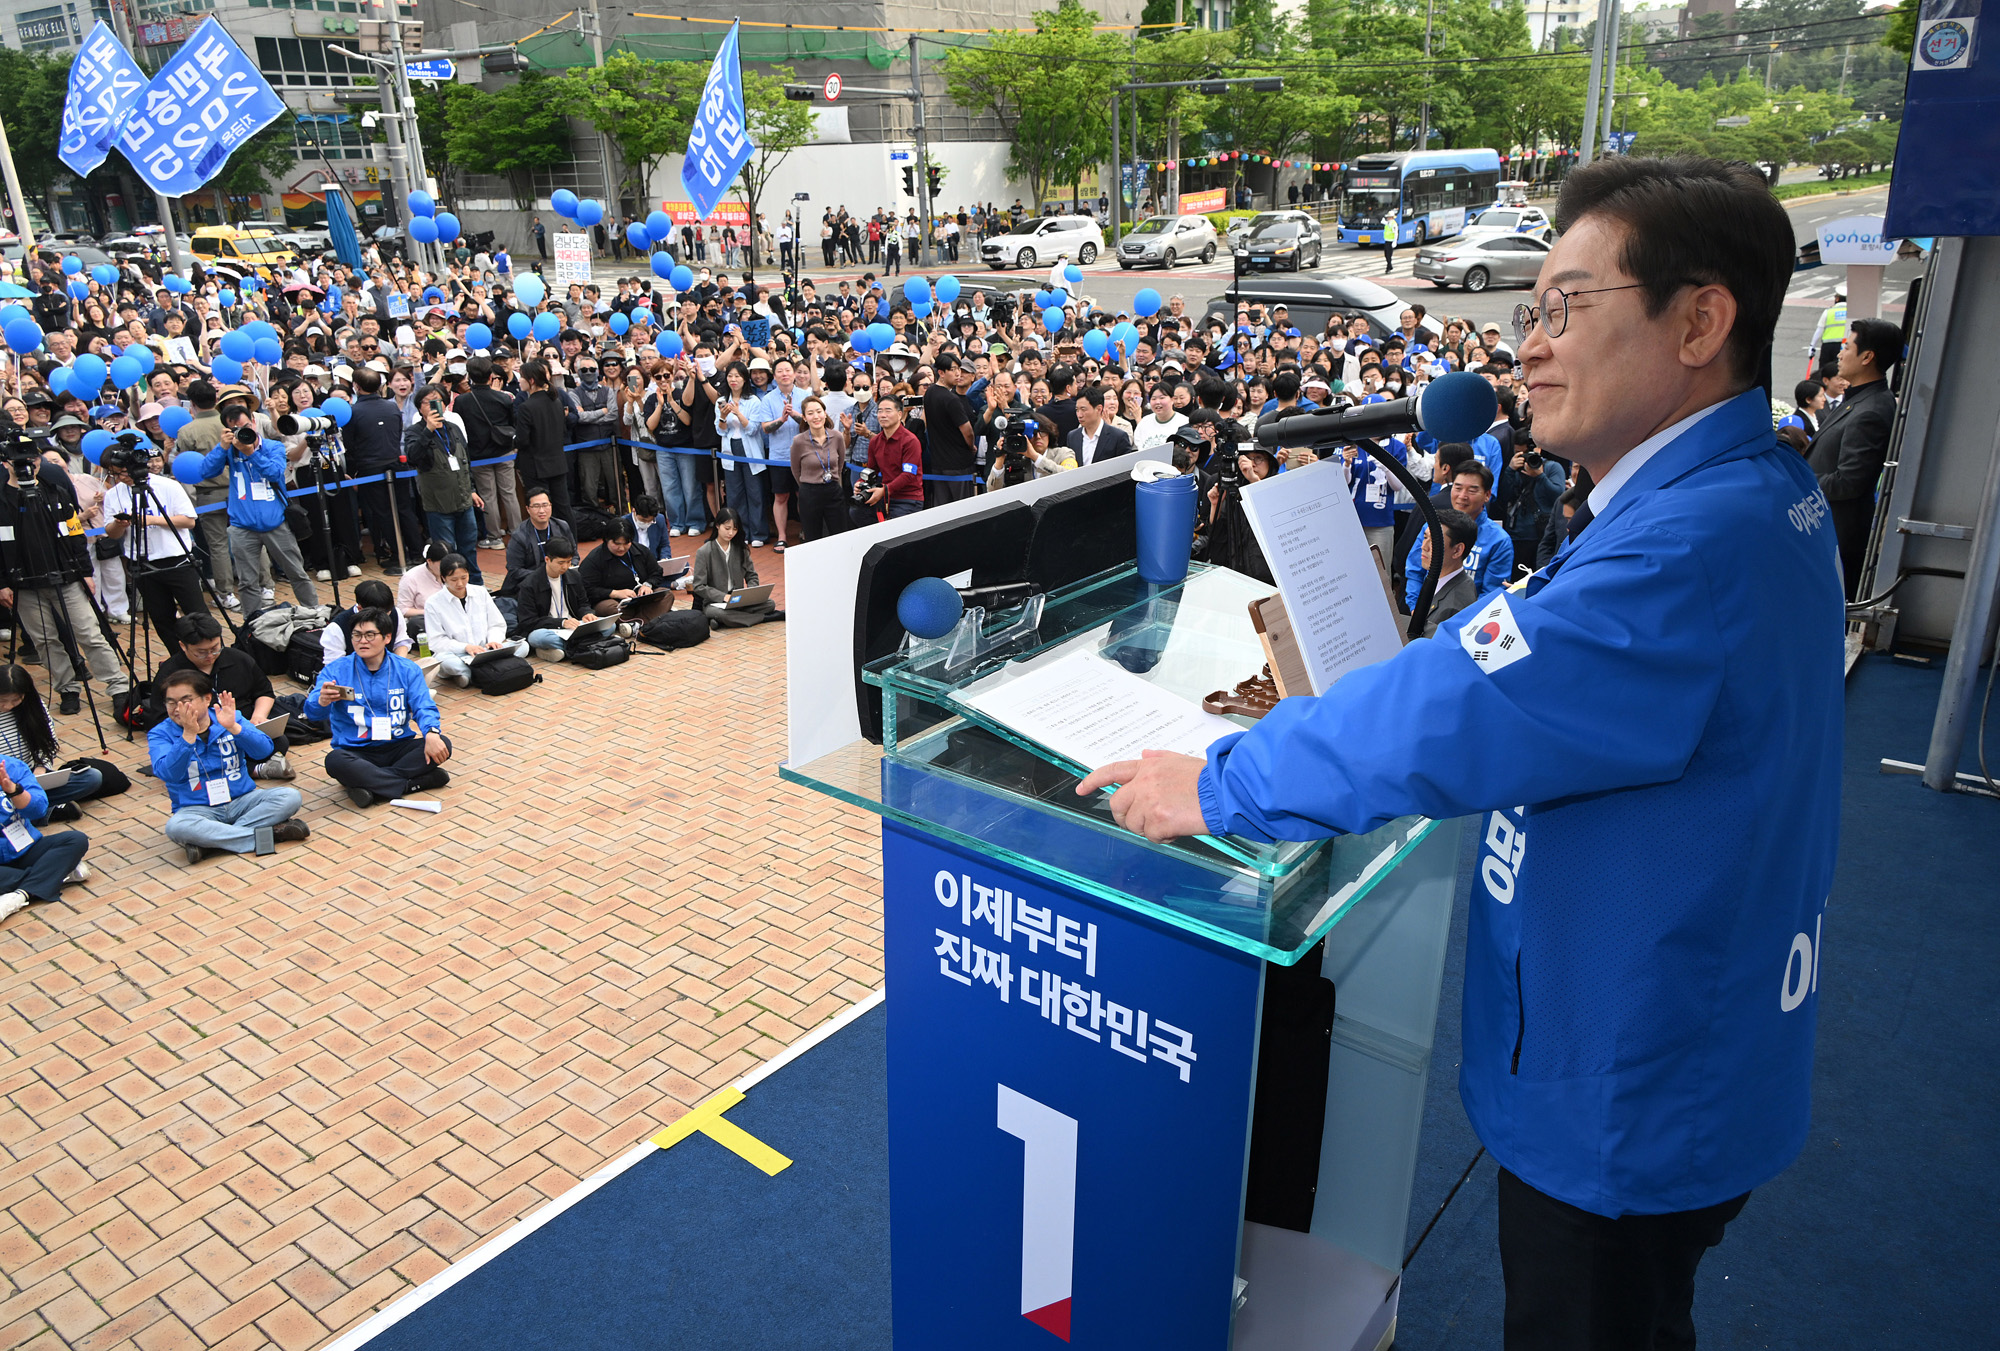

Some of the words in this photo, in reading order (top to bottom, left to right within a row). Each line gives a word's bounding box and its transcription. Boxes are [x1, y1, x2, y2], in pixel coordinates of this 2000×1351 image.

[1929, 38, 1957, 53] 선거
[827, 82, 838, 94] 30
[1357, 178, 1368, 186] 111
[347, 705, 368, 738] 1
[934, 870, 1098, 977] 이제부터
[934, 928, 1013, 1003] 진짜
[1020, 966, 1198, 1083] 대한민국
[997, 1082, 1078, 1343] 1
